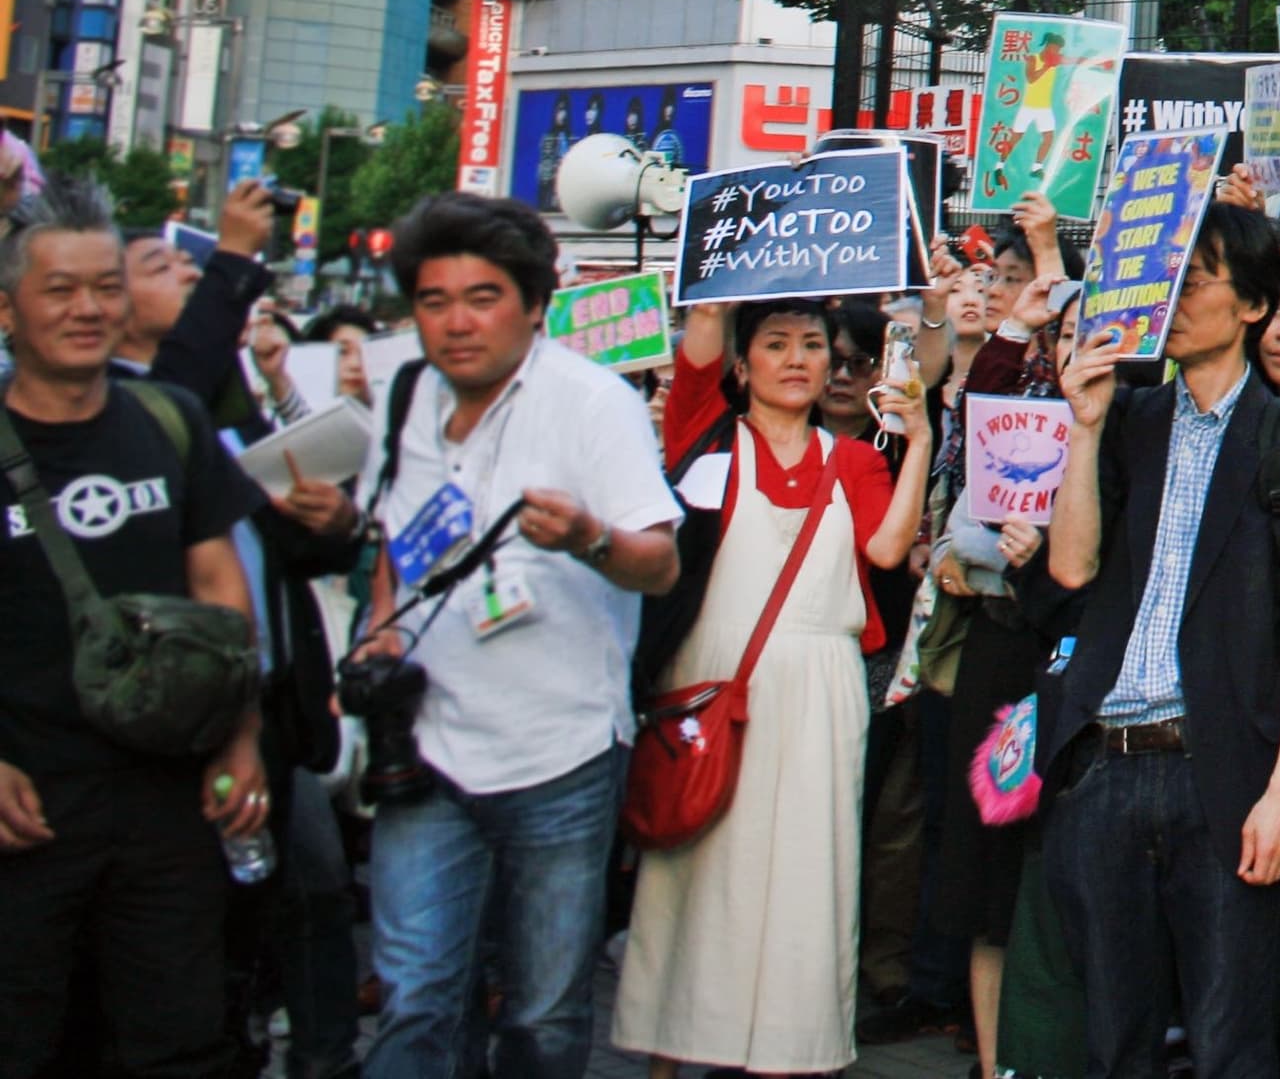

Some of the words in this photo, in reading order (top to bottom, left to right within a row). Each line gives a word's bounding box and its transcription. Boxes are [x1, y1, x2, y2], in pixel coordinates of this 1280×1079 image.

[984, 30, 1033, 198] 黙らない
[711, 173, 866, 214] #YouToo
[703, 207, 873, 251] #MeToo
[1113, 222, 1164, 253] START
[699, 240, 880, 279] #WithYou
[1116, 254, 1146, 281] THE
[572, 287, 630, 328] END
[976, 430, 987, 447] I
[986, 411, 1048, 436] WON'T
[988, 484, 1050, 513] SILEN
